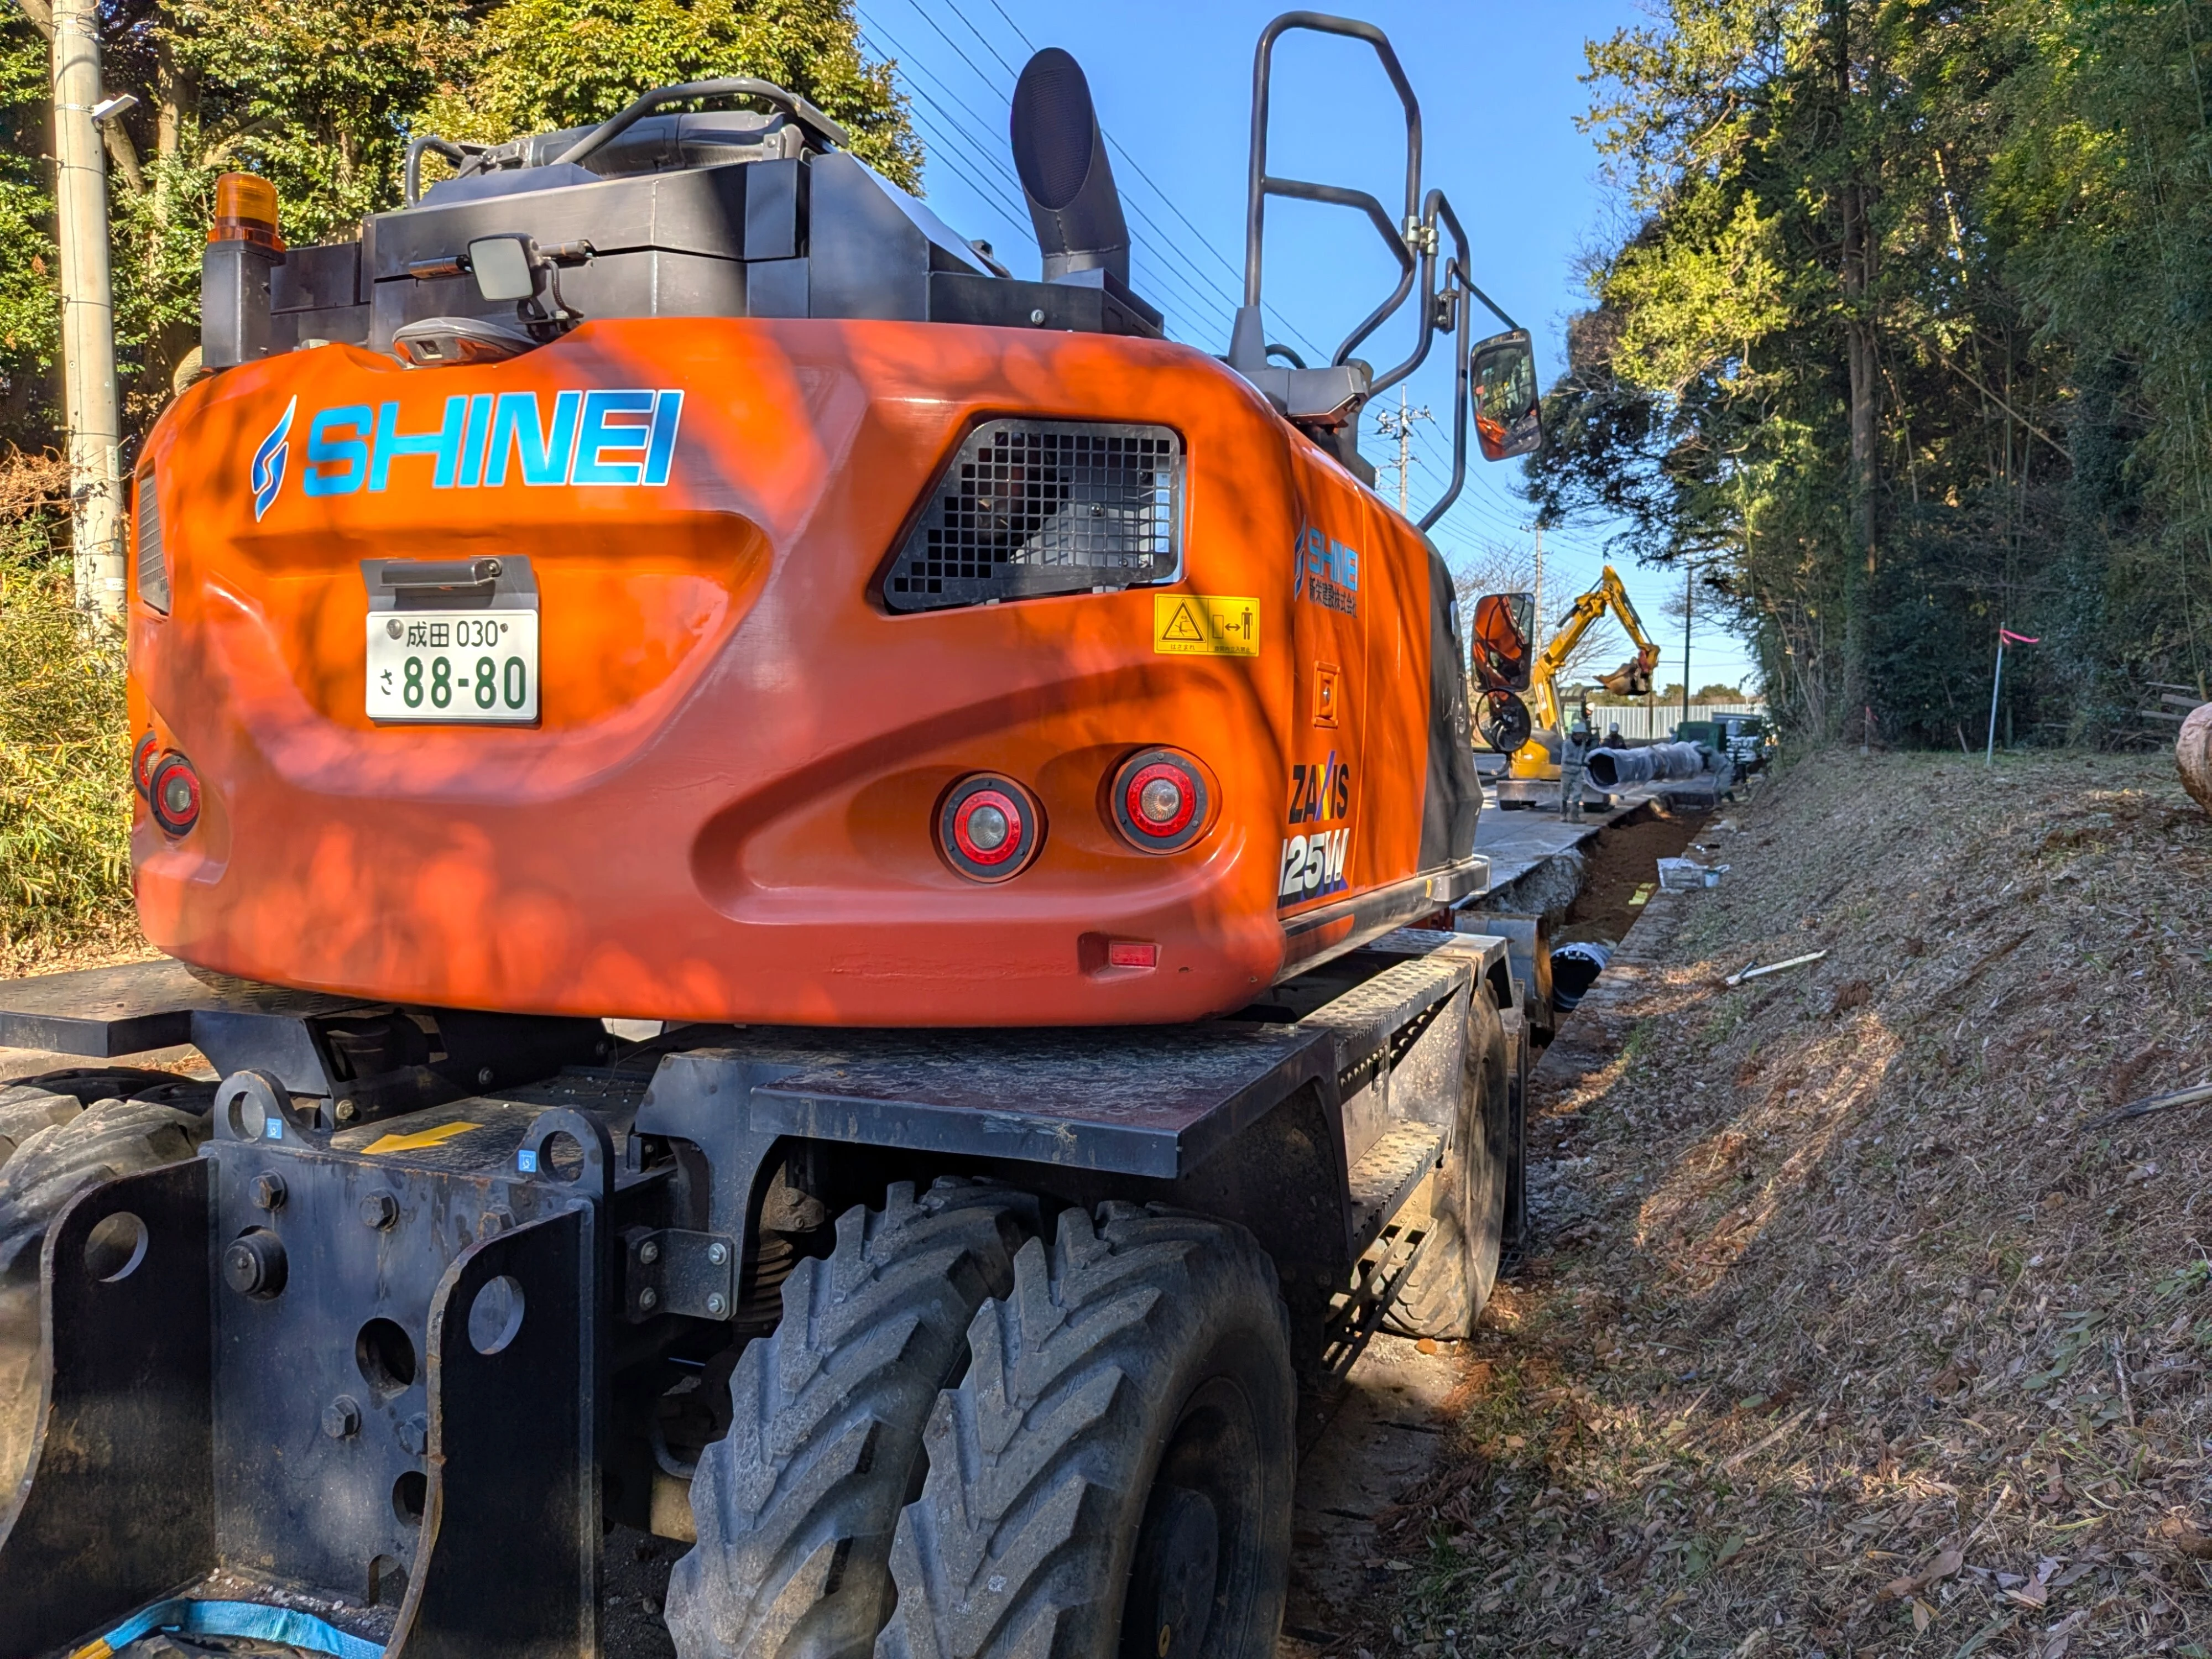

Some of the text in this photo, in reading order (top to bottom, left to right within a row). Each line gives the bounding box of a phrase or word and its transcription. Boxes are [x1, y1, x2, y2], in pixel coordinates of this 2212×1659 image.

[304, 390, 684, 497] SHINEI
[1308, 527, 1358, 592] SHINEI
[406, 620, 498, 647] 成田 030
[380, 656, 526, 709] さ 88-80
[1288, 750, 1349, 825] ZAXIS
